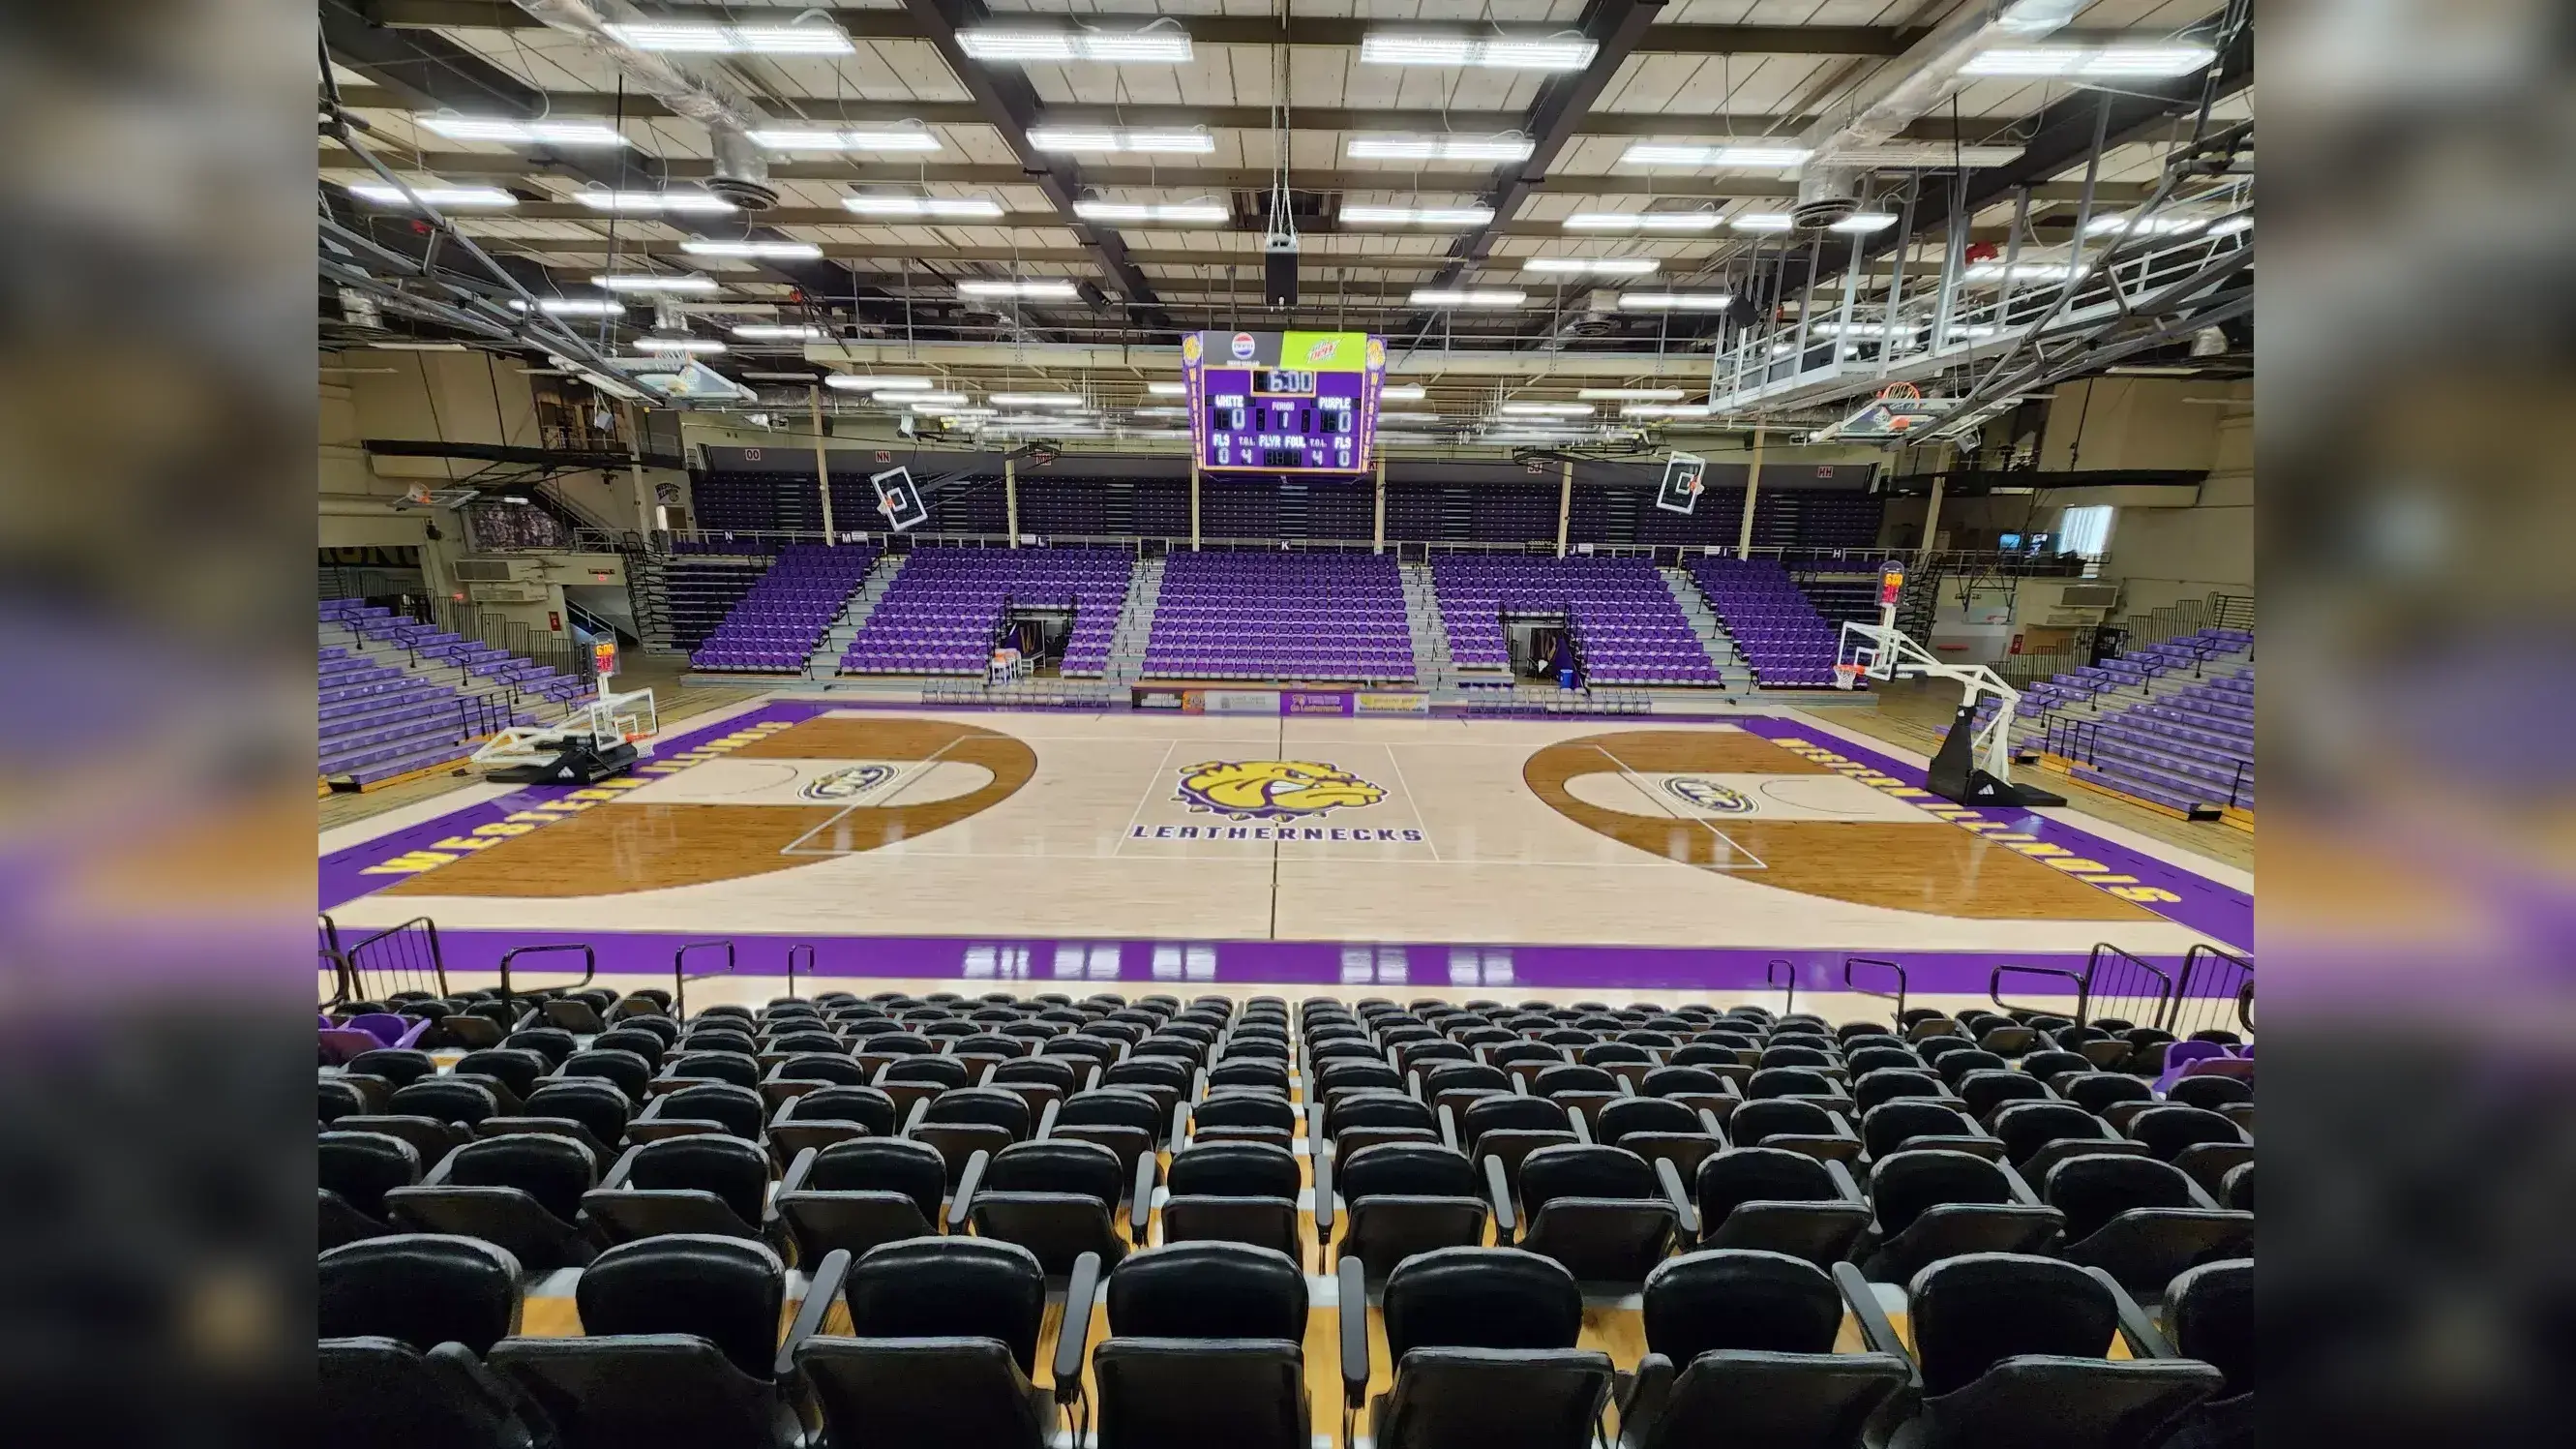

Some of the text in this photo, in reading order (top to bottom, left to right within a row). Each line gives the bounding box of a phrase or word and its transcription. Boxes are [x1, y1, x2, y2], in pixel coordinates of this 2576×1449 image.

[1270, 370, 1313, 392] 6:00
[1214, 395, 1243, 407] WHITE
[1272, 402, 1295, 410] PERIOD
[1319, 397, 1351, 409] PURPLE
[1232, 408, 1245, 430] 0
[1282, 411, 1289, 429] 1
[1337, 411, 1351, 433] 0
[1213, 434, 1230, 446] FLS
[1259, 435, 1306, 448] PLYR FOUL
[1334, 437, 1351, 449] FLS
[876, 452, 889, 462] NN
[1218, 447, 1229, 465] 0
[1241, 448, 1252, 465] 4
[1312, 450, 1323, 466] 4
[1339, 450, 1351, 467] 0
[1818, 468, 1832, 477] HH
[725, 531, 733, 541] N
[842, 533, 852, 543] M
[1038, 537, 1044, 547] L
[1282, 541, 1290, 550] K
[1570, 545, 1576, 555] J
[1834, 550, 1842, 558] H
[596, 644, 614, 656] 6:00
[359, 721, 794, 875] WESTERN ILLINOIS
[1770, 738, 2182, 902] WESTERN ILLINOIS
[1131, 825, 1424, 842] LEATHERNECKS
